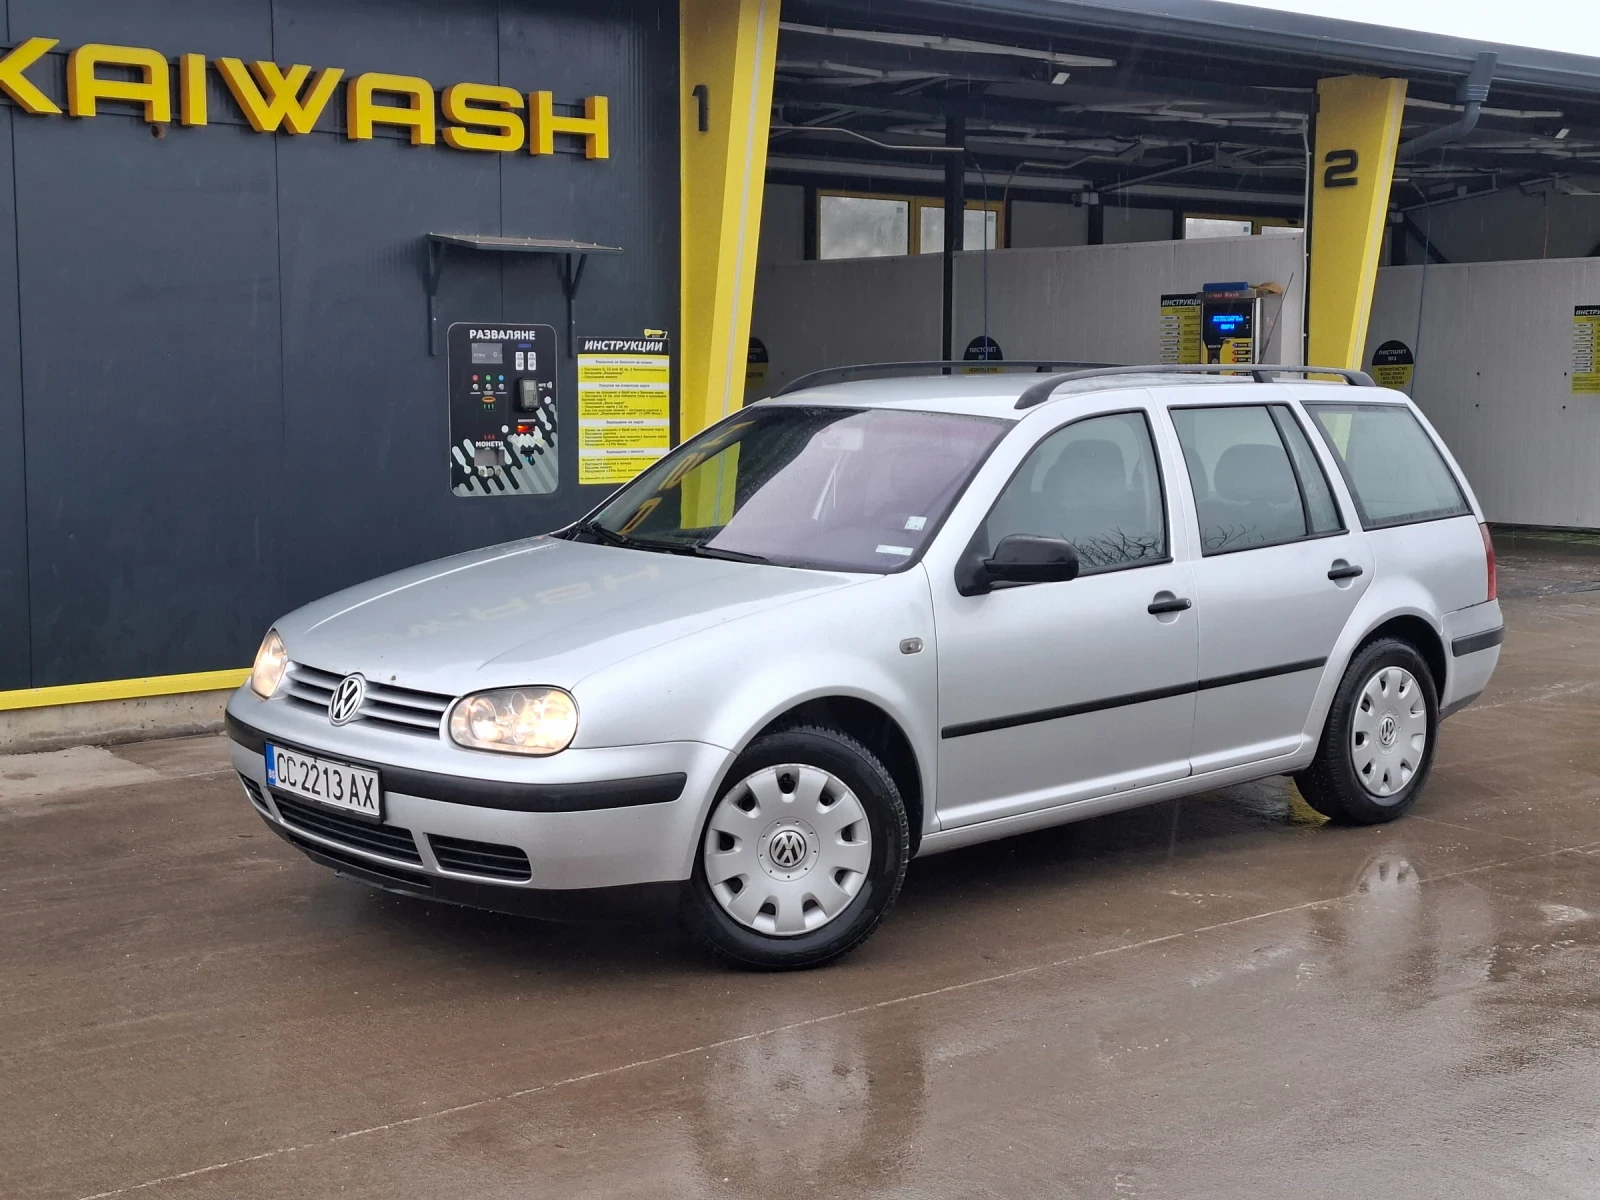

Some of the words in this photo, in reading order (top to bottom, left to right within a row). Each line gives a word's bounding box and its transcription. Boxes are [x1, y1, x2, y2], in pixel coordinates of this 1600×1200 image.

[692, 84, 709, 132] 1
[1323, 149, 1359, 188] 2
[469, 329, 536, 340] РАЗВАЛЯНЕ
[584, 340, 663, 352] ИНСТРУКЦИИ
[277, 752, 297, 787] CC
[300, 760, 344, 801] 2213
[349, 773, 375, 810] AX
